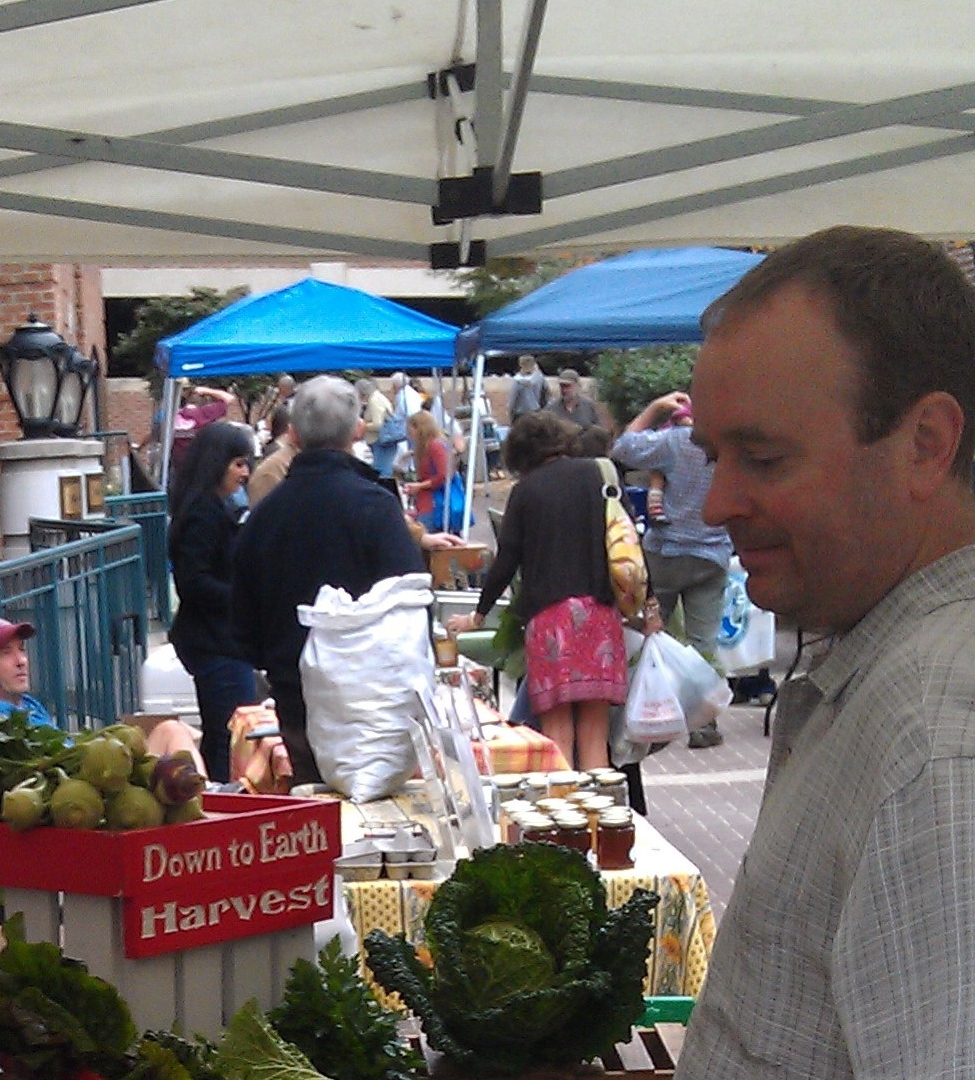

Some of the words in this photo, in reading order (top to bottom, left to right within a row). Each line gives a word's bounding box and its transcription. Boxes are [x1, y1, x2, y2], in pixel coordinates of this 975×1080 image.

[142, 843, 222, 883] Down
[228, 839, 255, 867] to
[258, 820, 328, 863] Earth
[140, 874, 329, 939] Harvest
